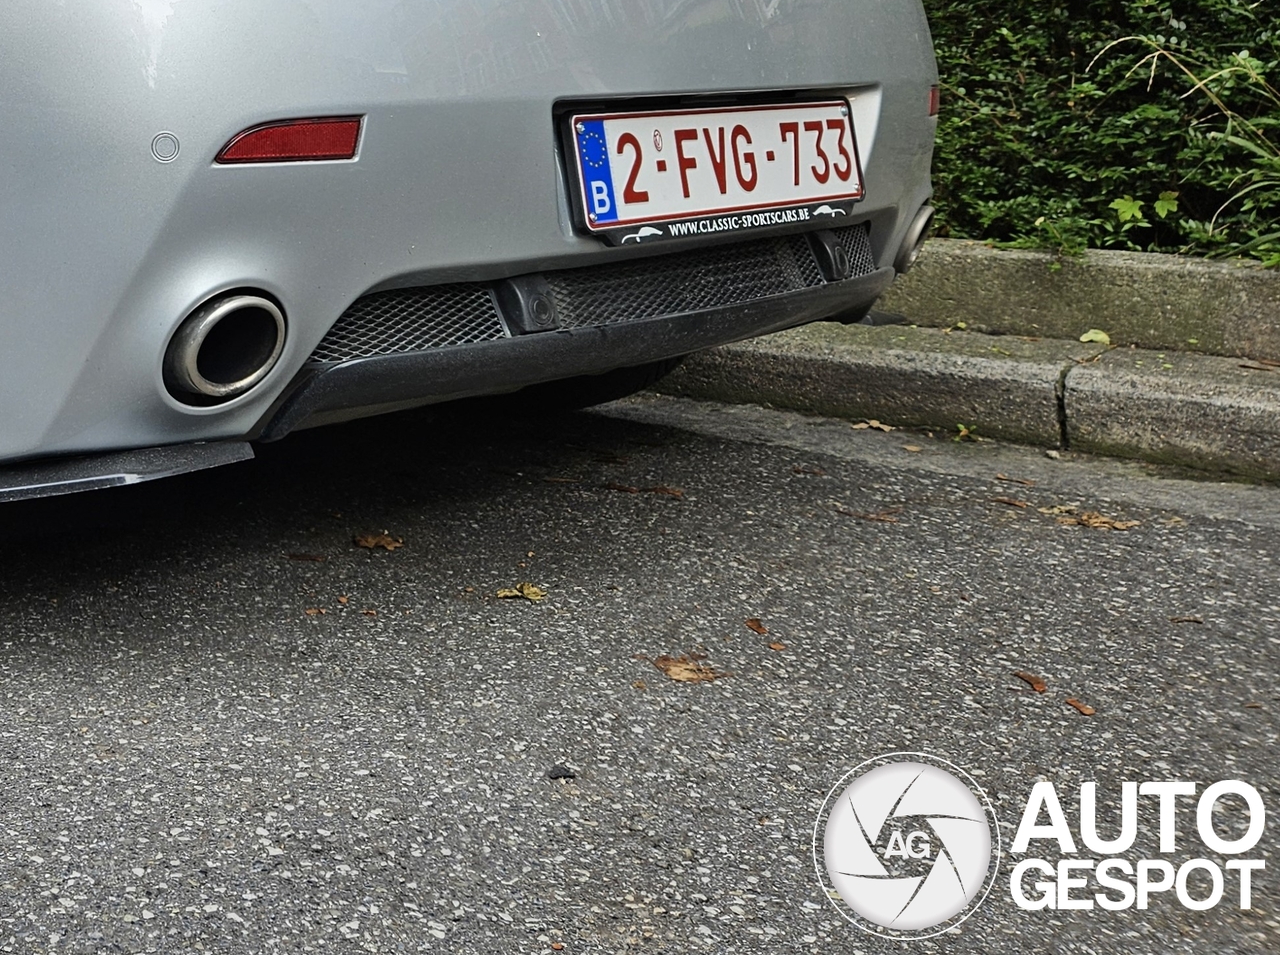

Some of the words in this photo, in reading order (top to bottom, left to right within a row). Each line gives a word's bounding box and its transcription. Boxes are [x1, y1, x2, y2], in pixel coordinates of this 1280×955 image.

[616, 119, 852, 204] 2-FVG-733
[590, 180, 611, 215] B
[668, 208, 810, 237] WWW.CLASSIC-SPORTSCARS.BE
